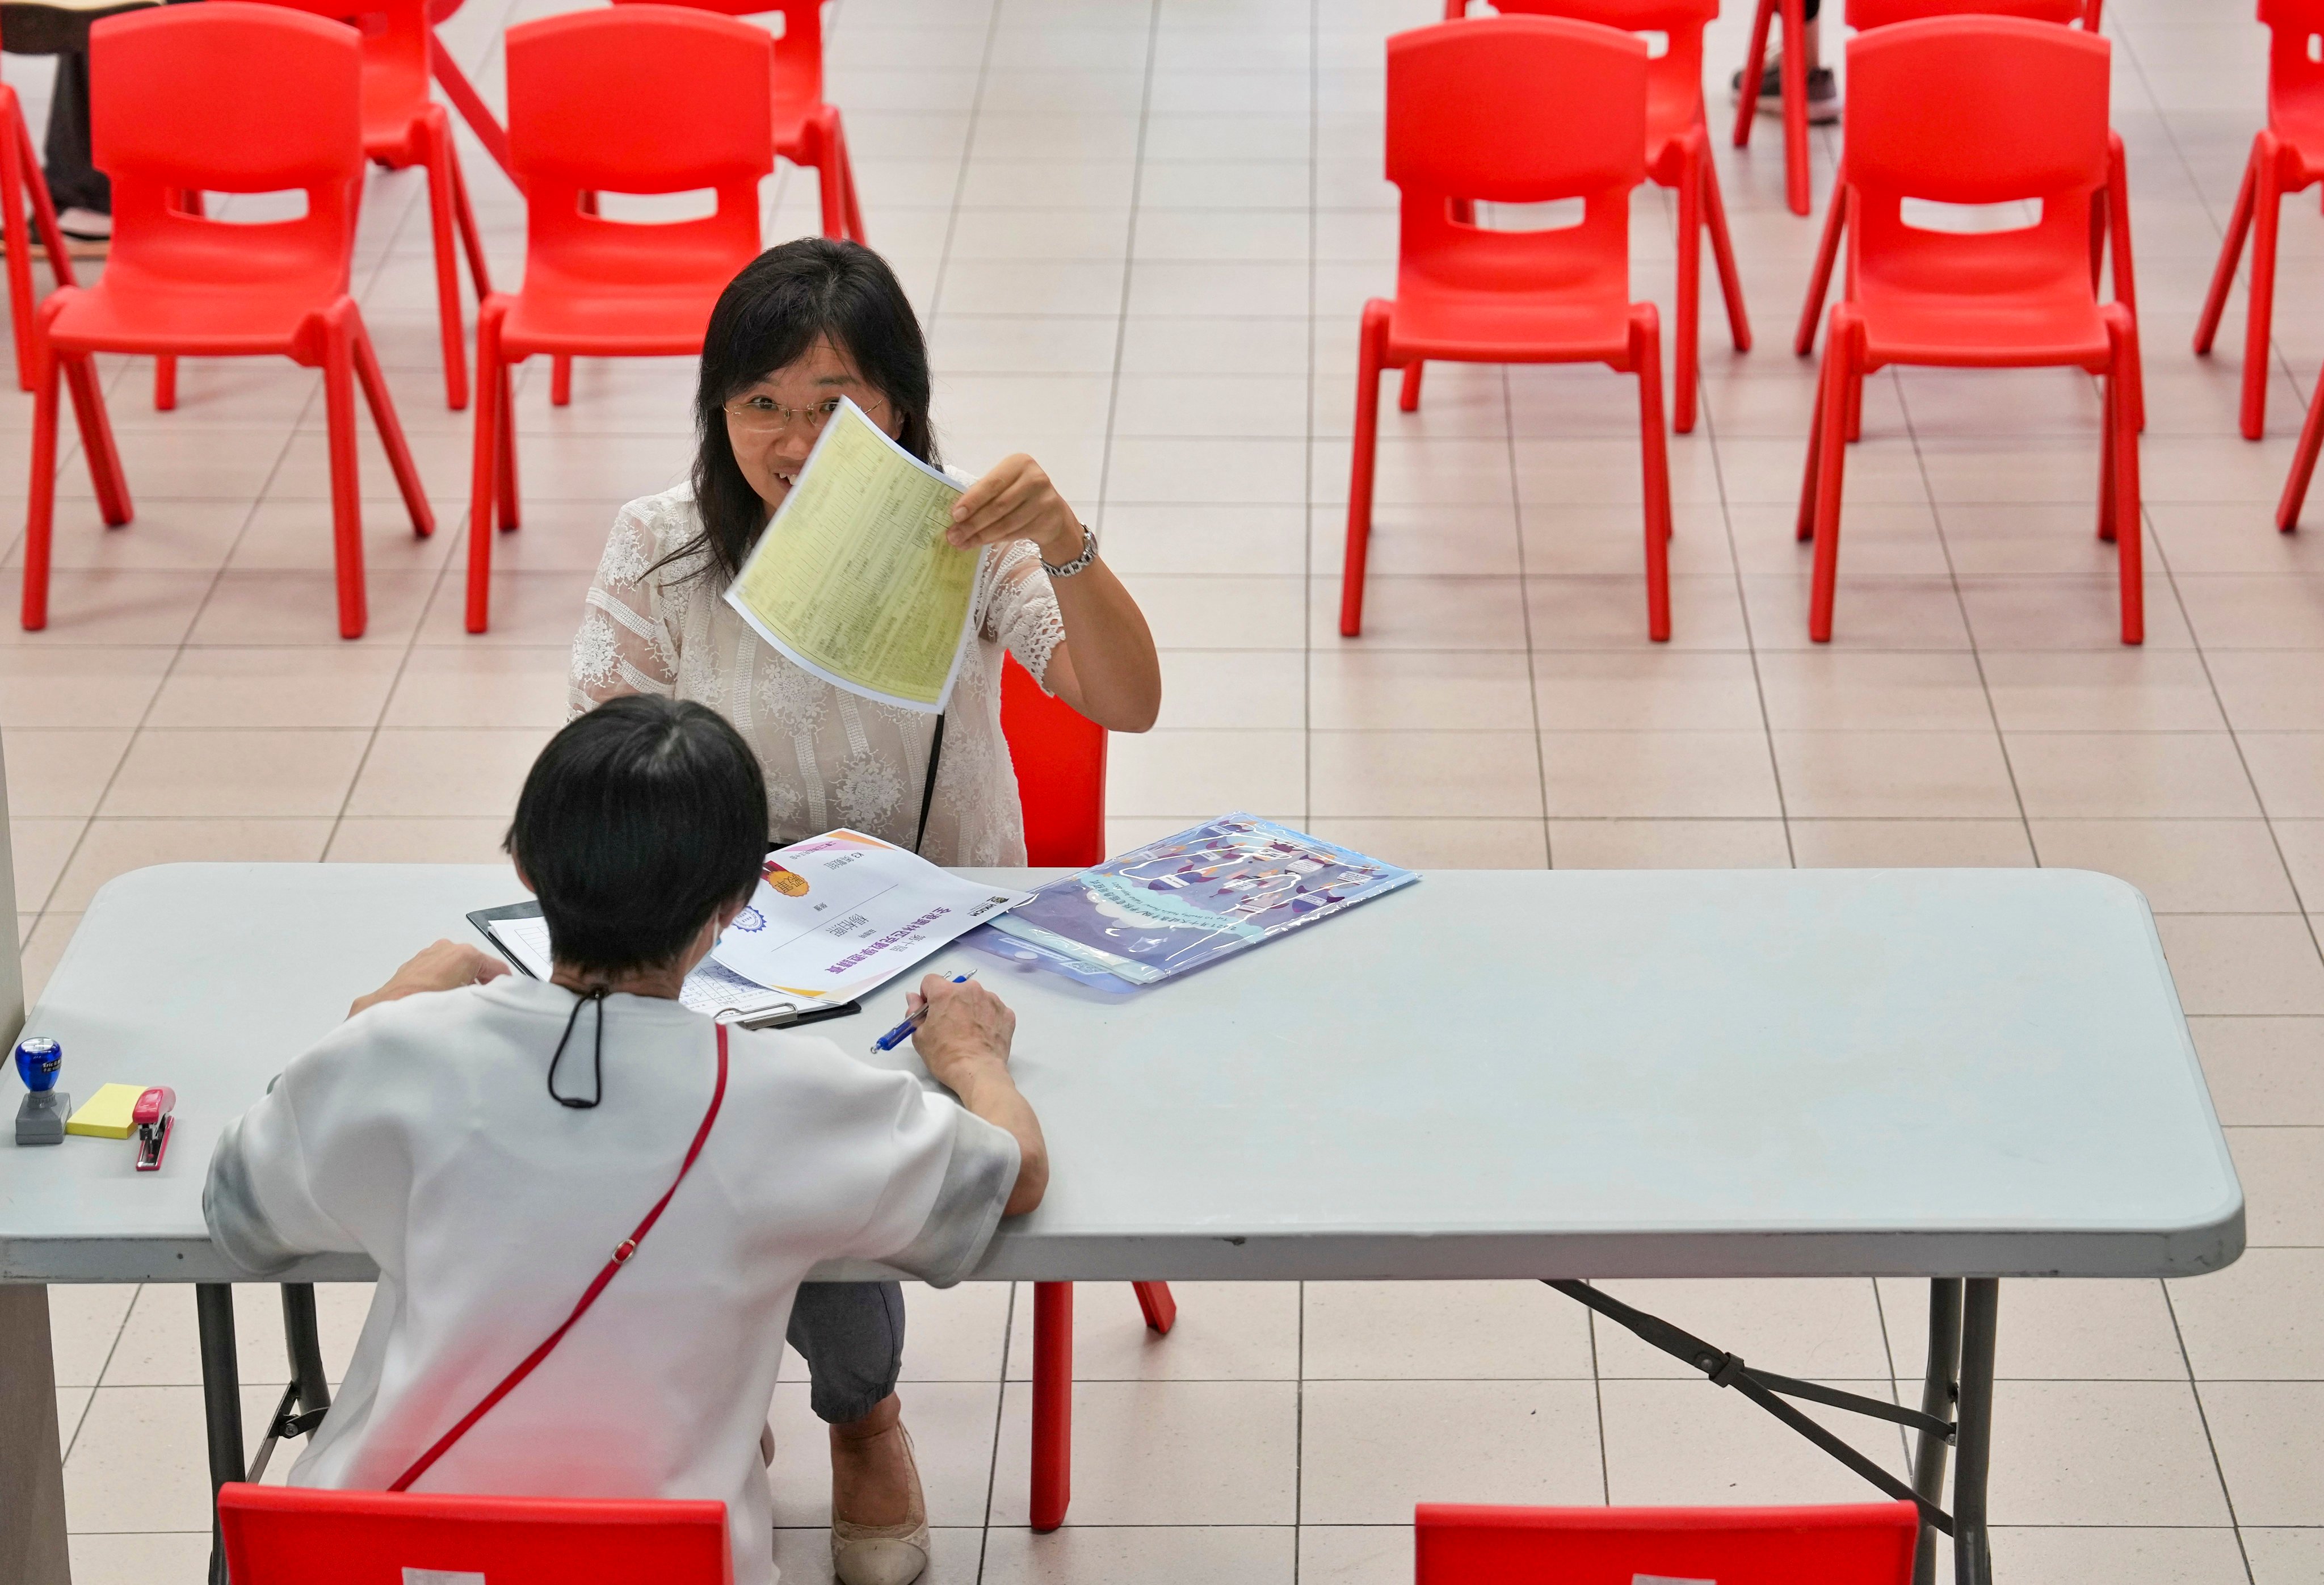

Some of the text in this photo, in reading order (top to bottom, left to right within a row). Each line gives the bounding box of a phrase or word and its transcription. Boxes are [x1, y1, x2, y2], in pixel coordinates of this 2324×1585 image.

[823, 856, 855, 870] 奧數組
[775, 874, 805, 894] 殿軍
[813, 902, 828, 912] 榮獲
[969, 903, 997, 917] HKICM
[824, 907, 952, 974] 全港奧林匹克數學邀請賽
[889, 934, 927, 952] 第十屆
